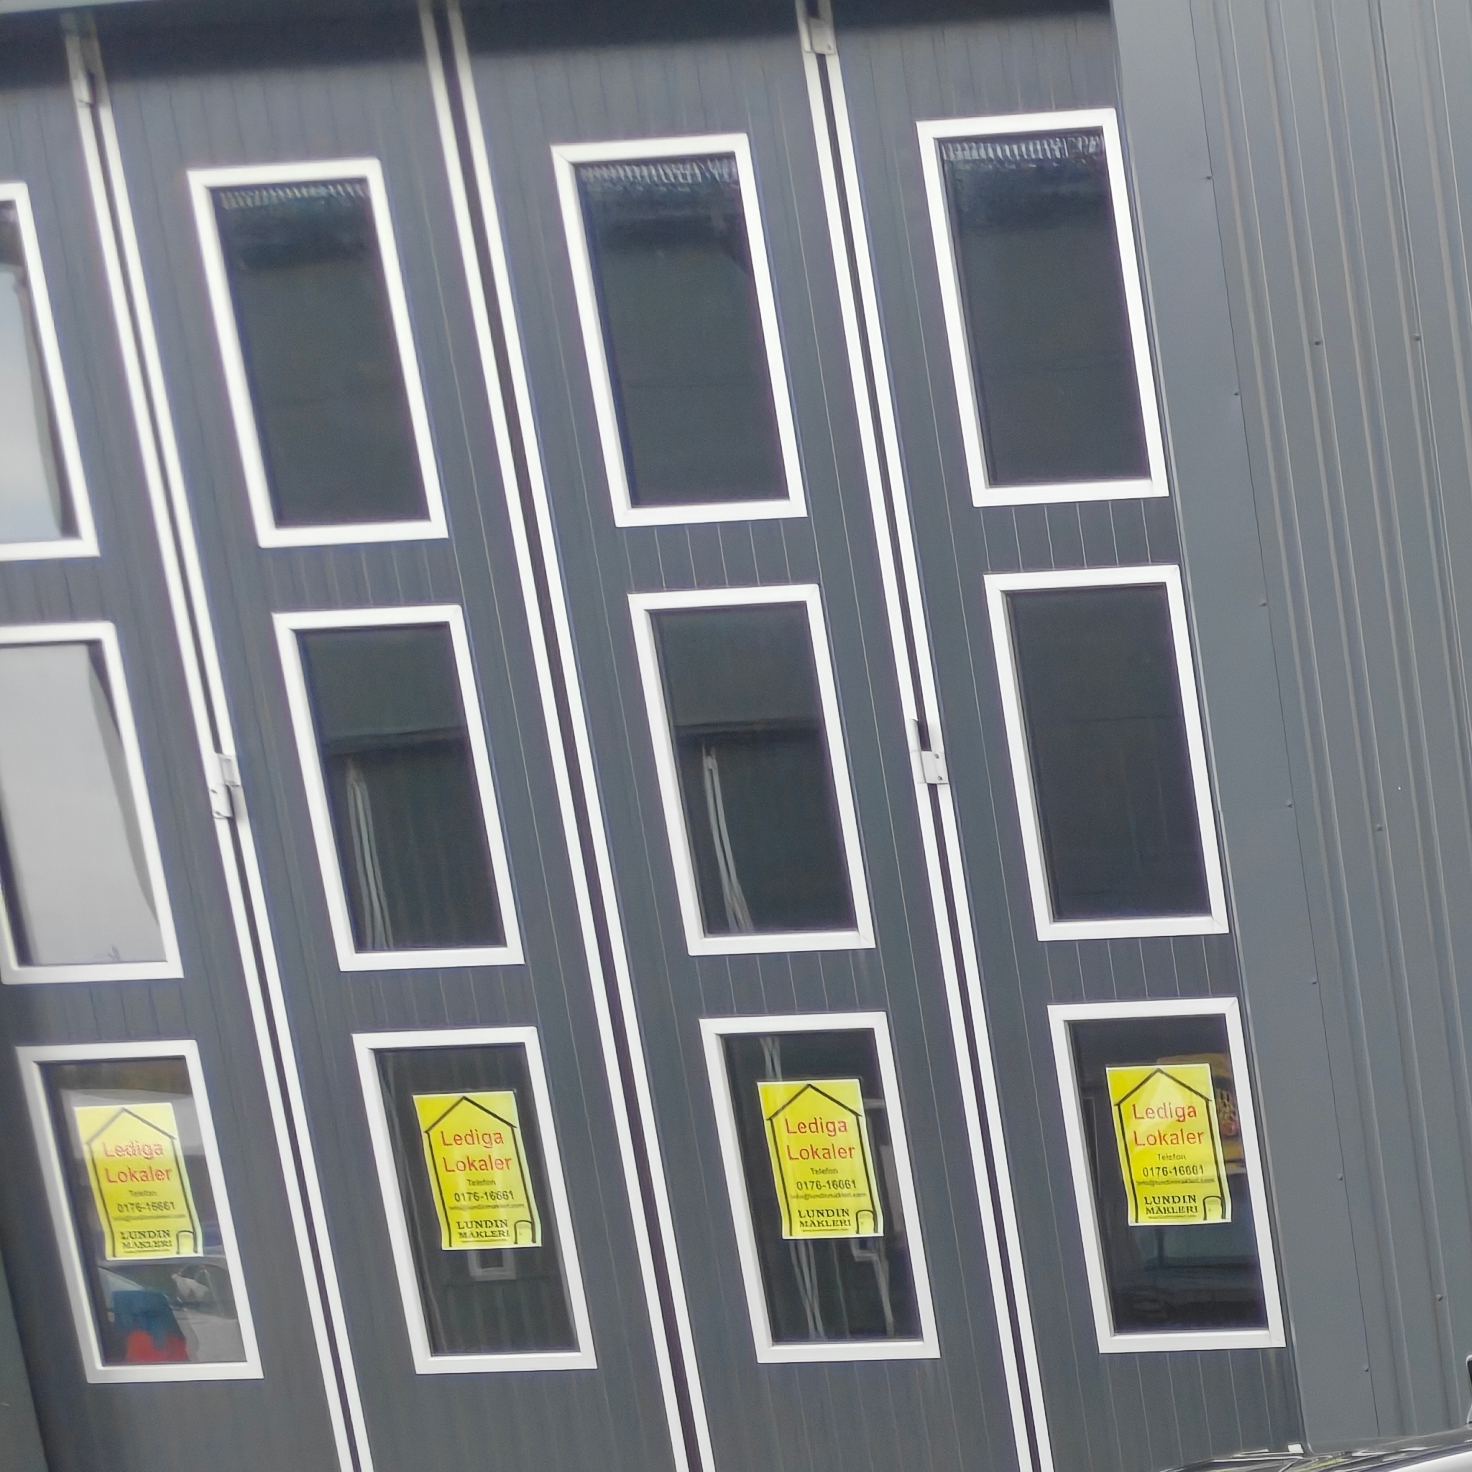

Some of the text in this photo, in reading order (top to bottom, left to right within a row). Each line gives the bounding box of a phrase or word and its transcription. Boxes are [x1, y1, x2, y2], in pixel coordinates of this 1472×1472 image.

[1132, 1102, 1197, 1122] Lediga
[785, 1117, 848, 1137] Lediga
[441, 1129, 504, 1148] Lediga
[1133, 1128, 1204, 1146] Lokaler
[103, 1140, 164, 1160] Lediga
[786, 1143, 855, 1160] Lokaler
[443, 1154, 512, 1172] Lokaler
[105, 1166, 172, 1183] Lokaler
[1144, 1194, 1197, 1205] LUNDIN
[798, 1208, 850, 1218] LUNDIN
[456, 1219, 508, 1229] LUNDIN
[120, 1229, 171, 1240] LUNDIN
